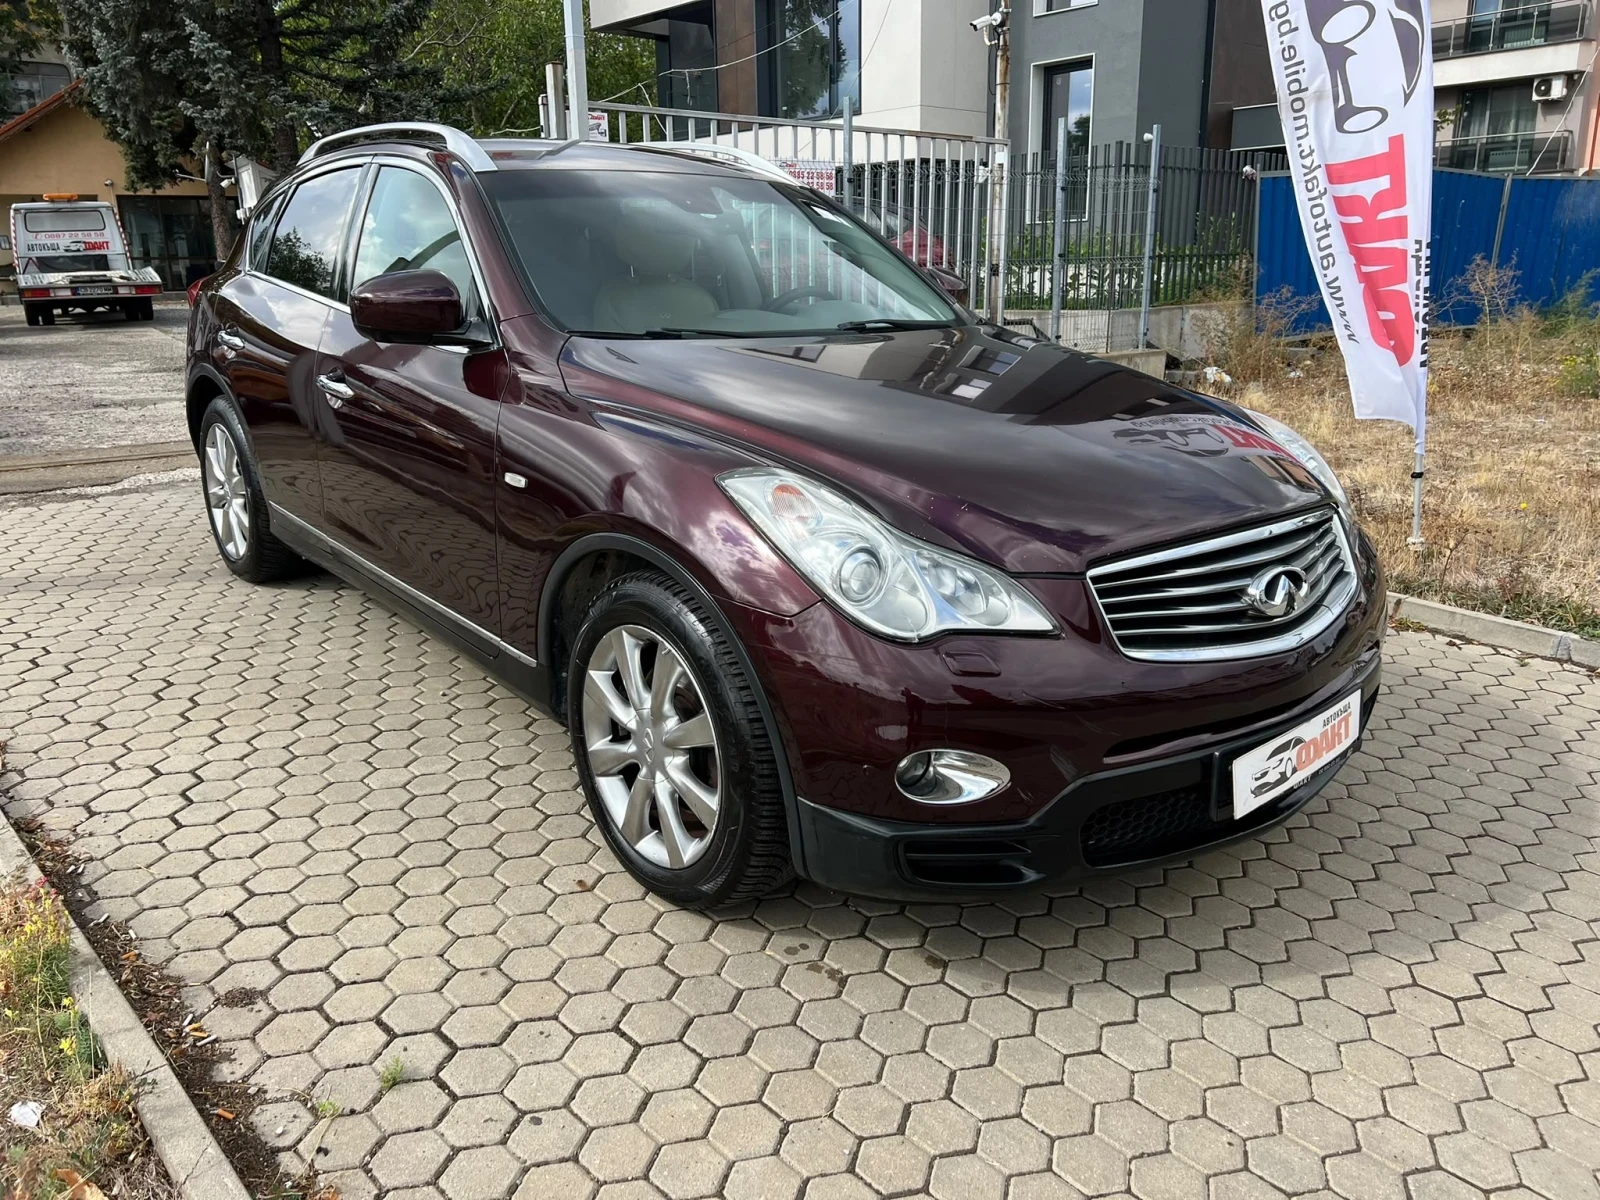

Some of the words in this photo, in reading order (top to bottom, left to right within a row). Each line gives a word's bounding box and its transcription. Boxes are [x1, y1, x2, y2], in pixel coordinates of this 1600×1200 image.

[27, 242, 60, 252] АВТОКЪЩА
[1322, 702, 1351, 729] АВТОКЪЩА
[1296, 711, 1352, 772] ФАКТ
